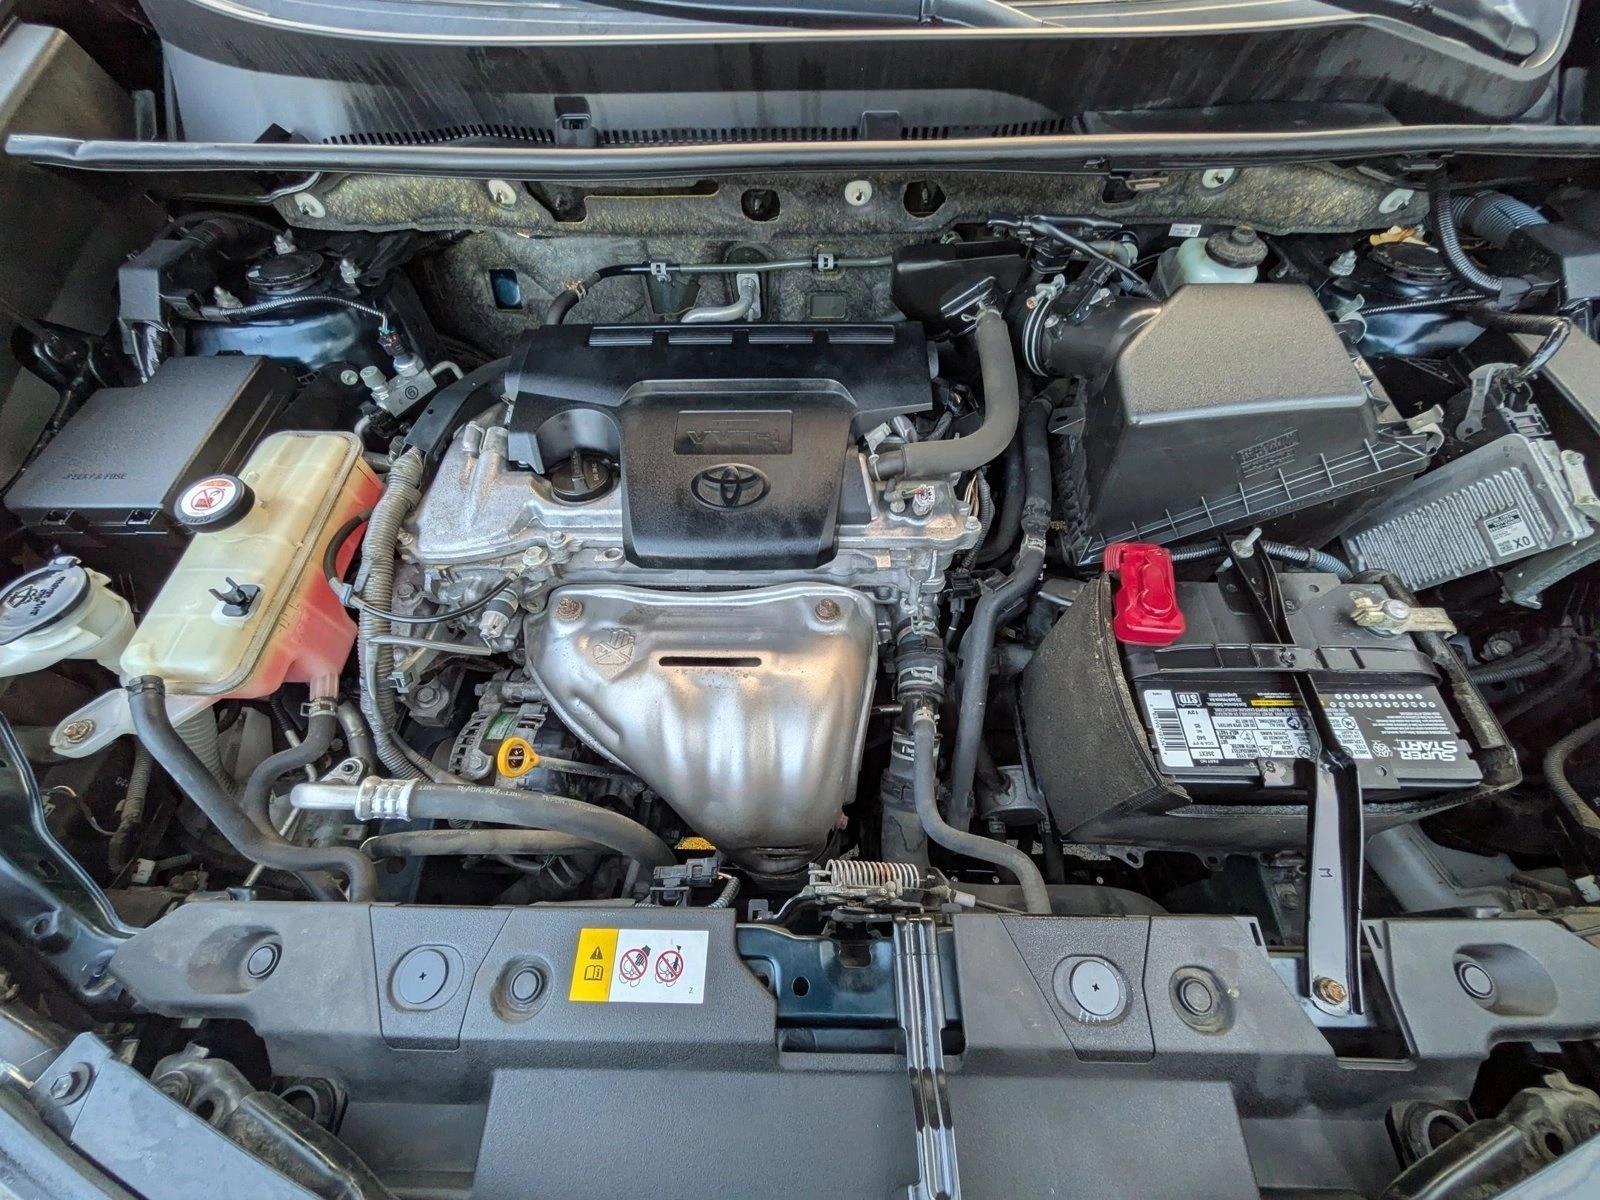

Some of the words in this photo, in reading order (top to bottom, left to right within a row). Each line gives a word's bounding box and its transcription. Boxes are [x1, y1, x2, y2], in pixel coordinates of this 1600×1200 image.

[1179, 695, 1198, 704] STD
[1396, 741, 1458, 753] START
[1400, 751, 1456, 762] SUPER
